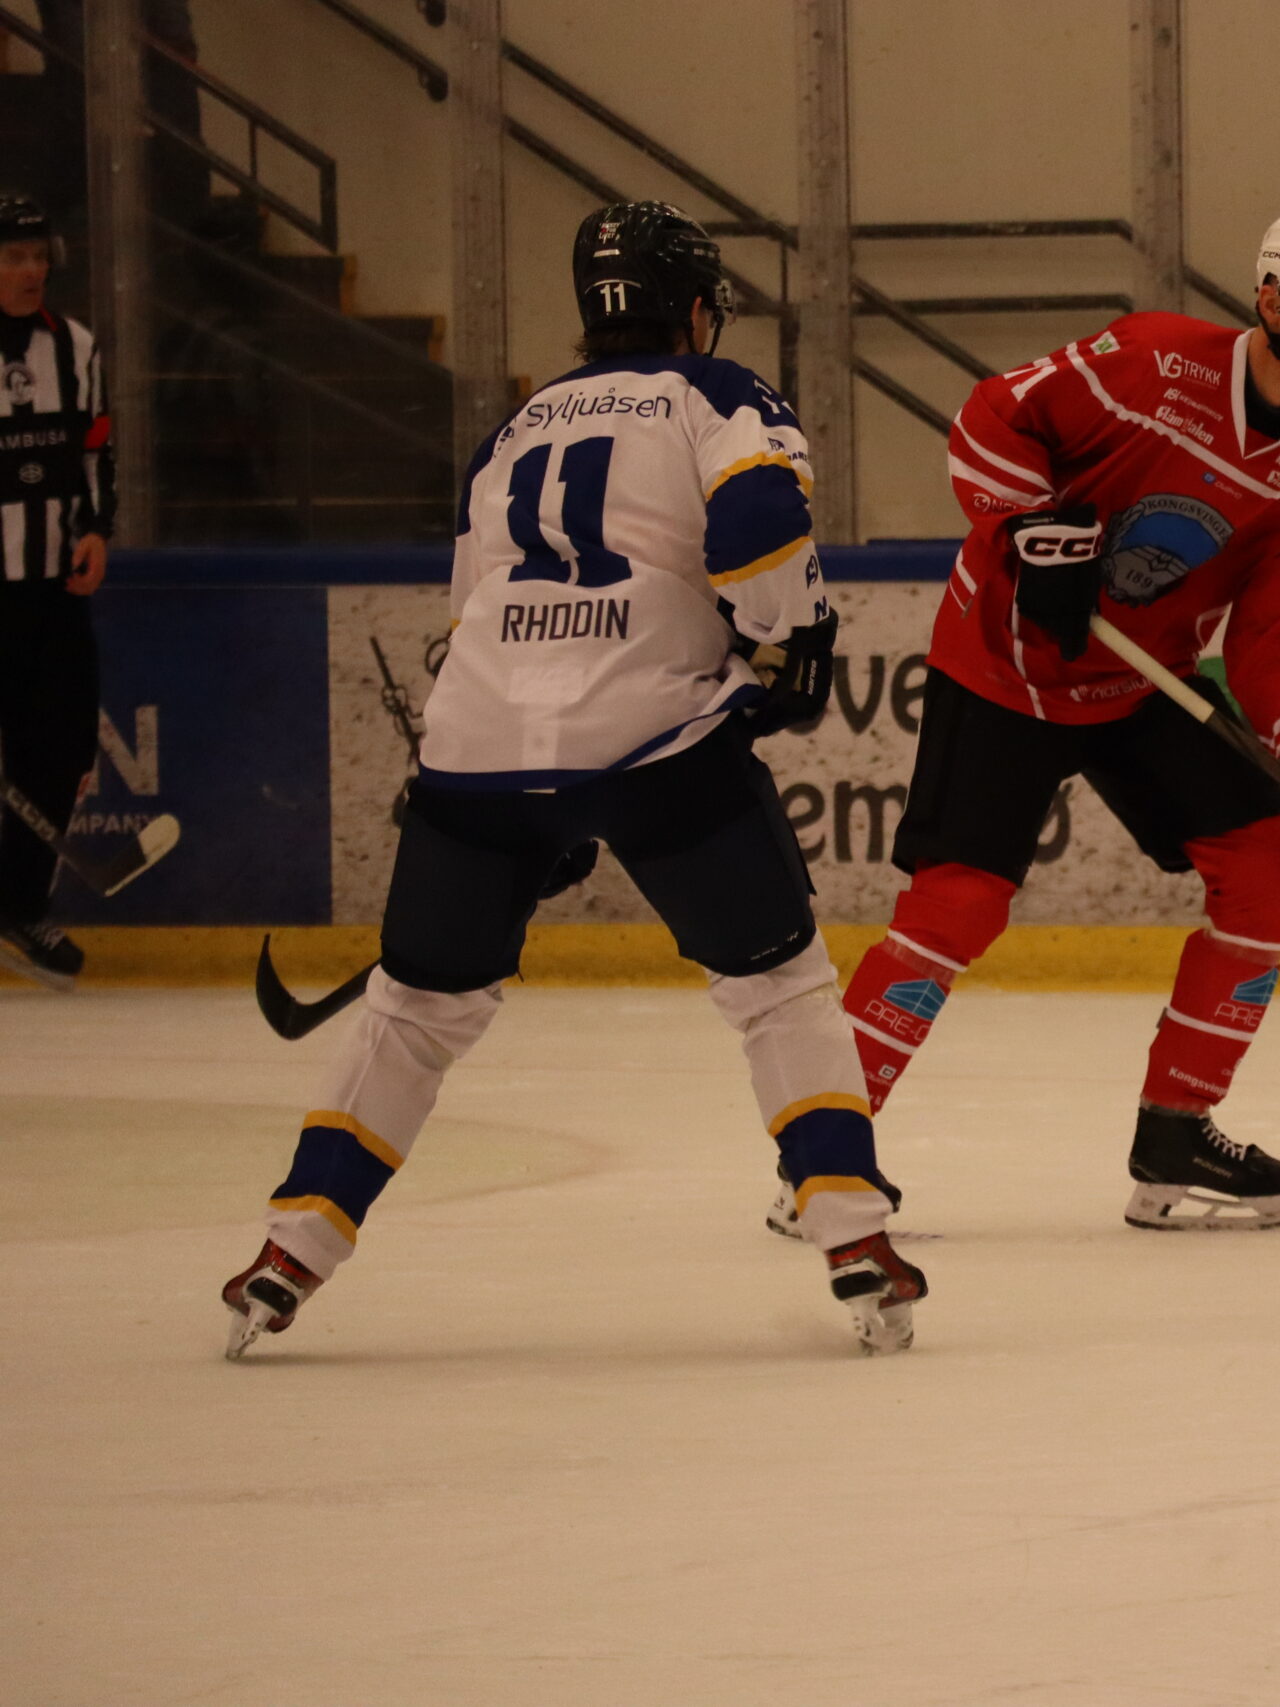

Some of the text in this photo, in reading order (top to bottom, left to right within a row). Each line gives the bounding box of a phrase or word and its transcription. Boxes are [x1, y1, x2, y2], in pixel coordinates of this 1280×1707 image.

[600, 284, 626, 313] 11
[506, 436, 633, 587] 11
[1145, 499, 1230, 541] KONGSVINGE
[1126, 568, 1154, 588] 189
[501, 599, 630, 643] RHODIN
